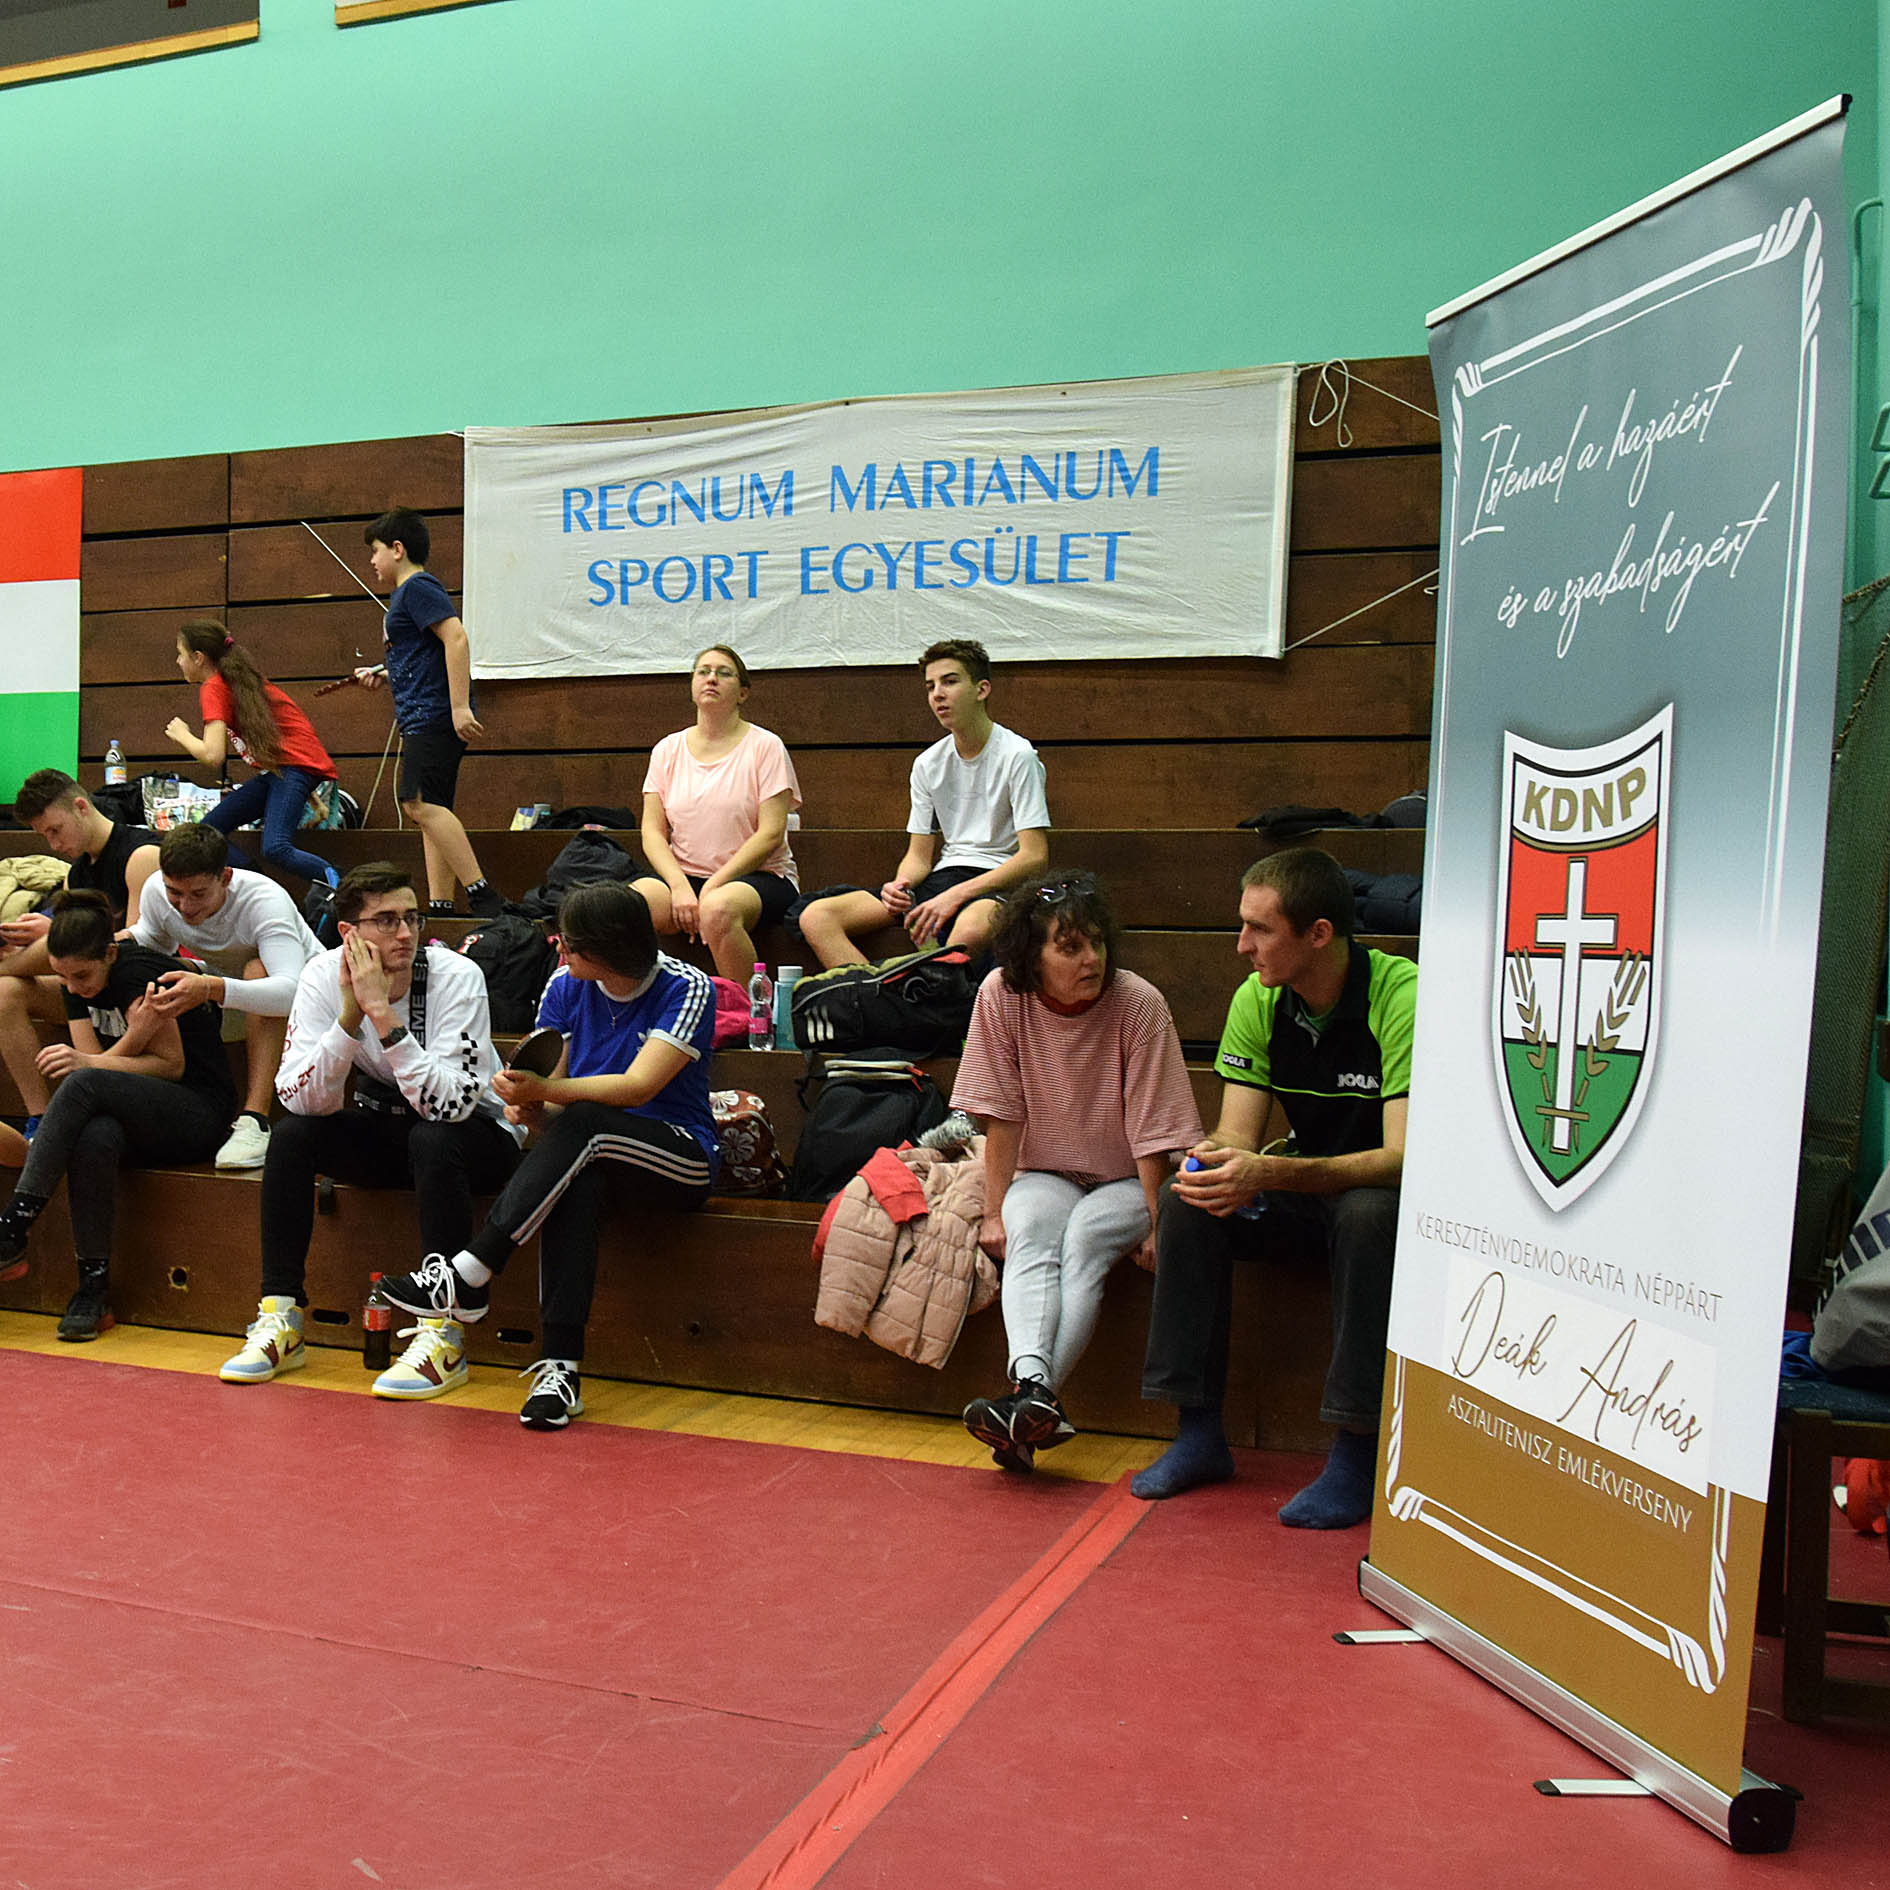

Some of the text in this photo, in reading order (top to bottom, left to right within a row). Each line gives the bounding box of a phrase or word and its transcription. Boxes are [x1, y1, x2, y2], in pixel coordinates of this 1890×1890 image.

[562, 446, 1160, 533] REGNUM MARIANUM
[1460, 345, 1743, 546] Istennel a hazáért
[587, 526, 1132, 607] SPORT EGYESÜLET
[1497, 481, 1780, 659] és a szabadságért
[1522, 766, 1647, 833] KDNP
[1415, 1211, 1723, 1323] KERESZTÉNYDEMOKRATA NÉPPÁRT
[1451, 1271, 1703, 1453] Deák András
[1447, 1394, 1693, 1533] ASZTALITENISZ EMLÉKVERSENY
